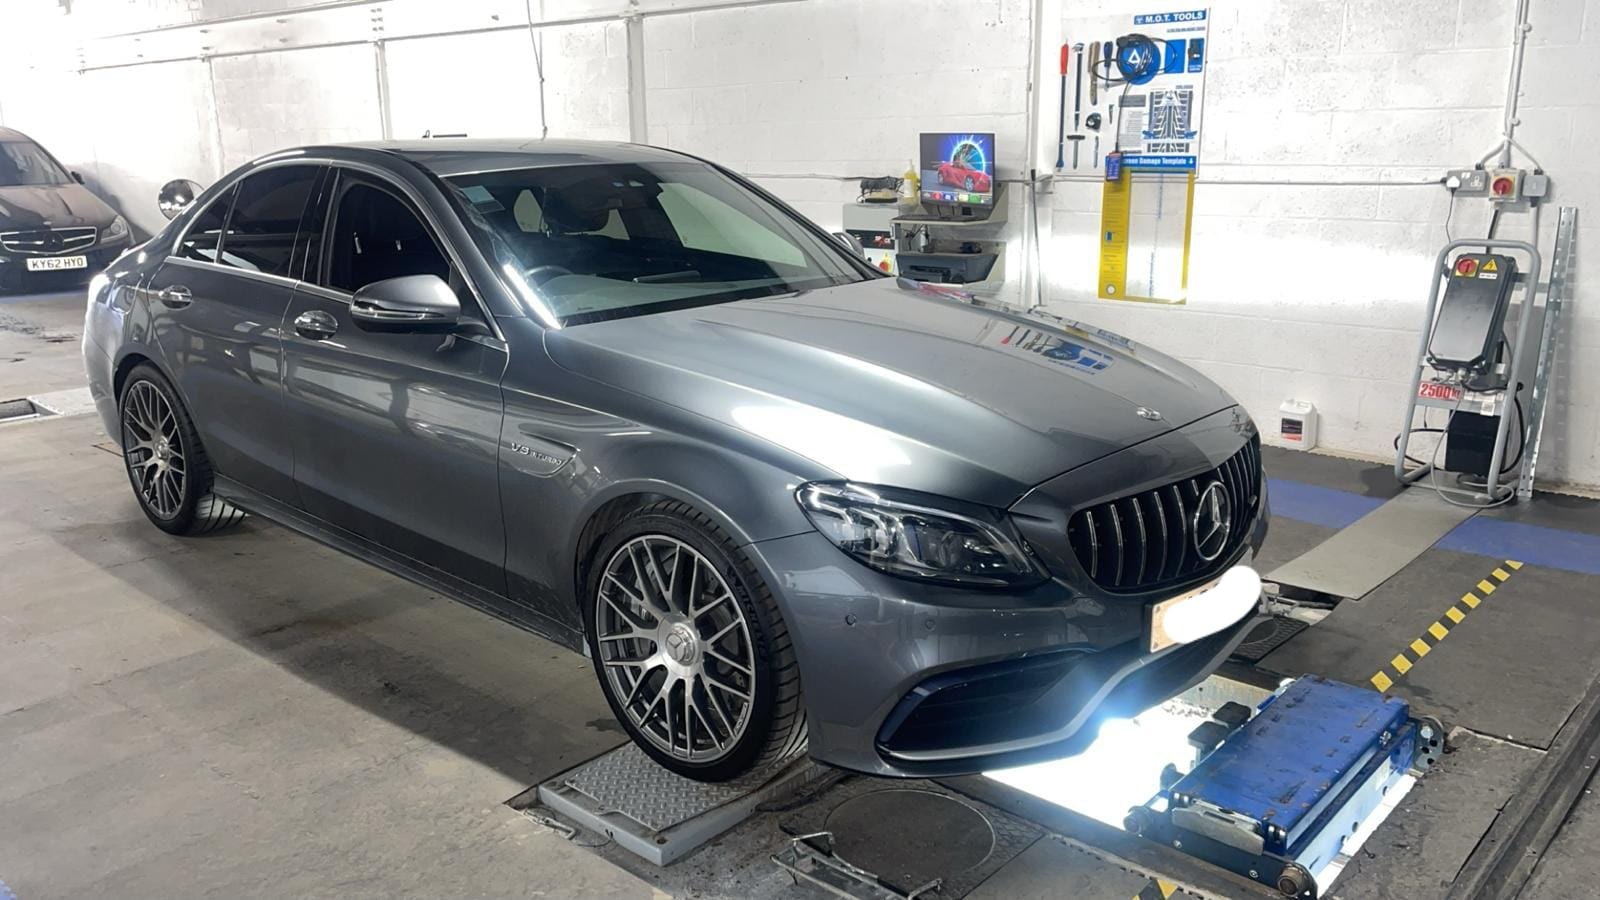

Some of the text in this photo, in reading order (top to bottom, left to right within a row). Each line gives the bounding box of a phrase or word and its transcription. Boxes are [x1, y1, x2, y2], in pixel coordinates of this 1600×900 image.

[1145, 12, 1203, 23] M.O.T. TOOLS
[32, 259, 61, 269] KY62
[1420, 383, 1451, 399] 2500
[511, 442, 530, 455] V8
